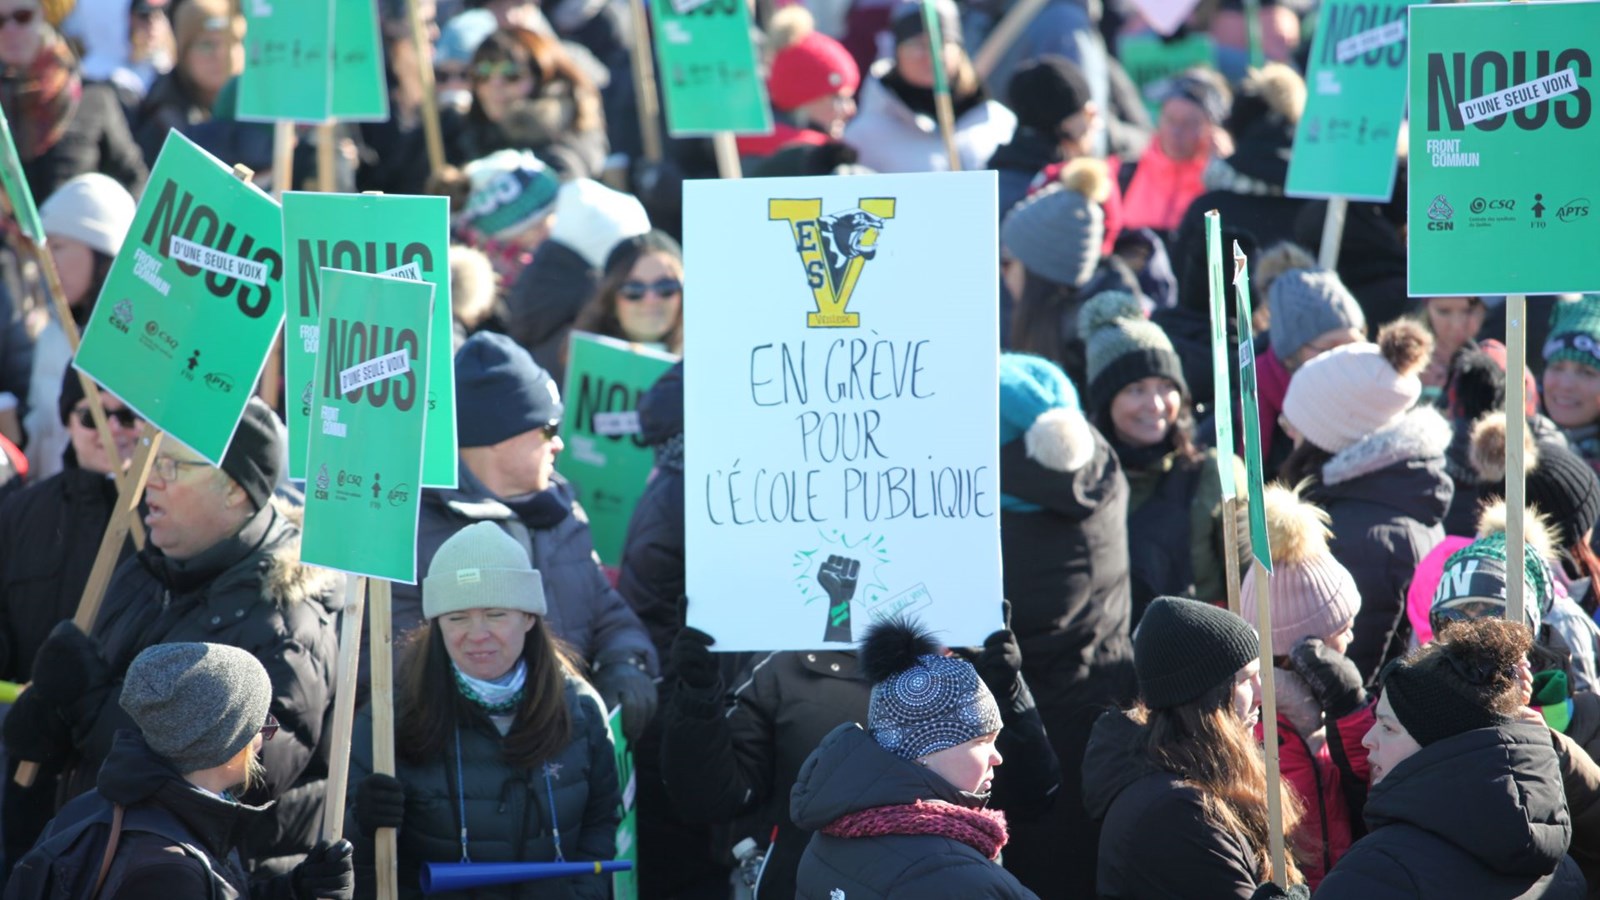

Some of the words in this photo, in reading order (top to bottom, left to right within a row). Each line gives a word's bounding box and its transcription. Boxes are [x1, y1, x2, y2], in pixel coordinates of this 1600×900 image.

[1427, 48, 1592, 132] NOUS
[1465, 96, 1502, 120] D'UNE
[1503, 84, 1540, 107] SEULE
[1542, 74, 1572, 95] VOIX
[1427, 139, 1461, 153] FRONT
[1432, 153, 1480, 167] COMMUN
[1427, 221, 1454, 231] CSN
[1488, 199, 1516, 210] CSQ
[1555, 206, 1589, 218] APTS
[142, 177, 283, 319] NOUS
[174, 241, 202, 262] D'UNE
[203, 251, 235, 272] SEULE
[237, 261, 262, 281] VOIX
[323, 318, 418, 411] NOUS
[363, 360, 385, 380] SEULE
[751, 340, 808, 406] EN
[825, 329, 935, 403] GRÈVE
[796, 409, 888, 463] POUR
[706, 458, 828, 525] L'ÉCOLE
[844, 455, 994, 522] PUBLIQUE
